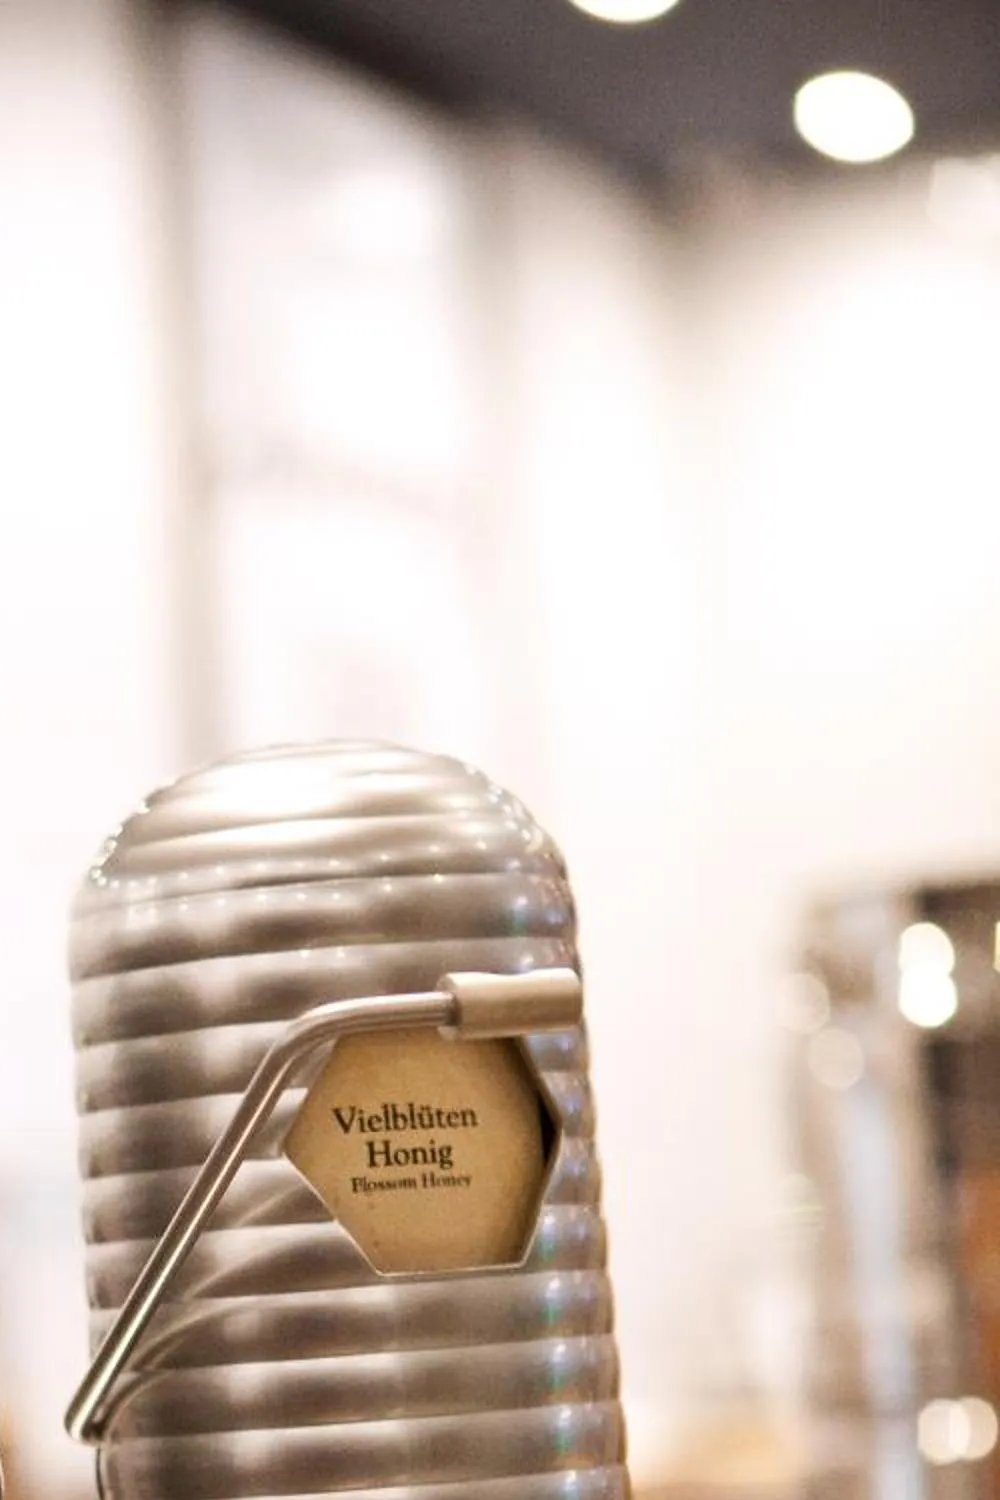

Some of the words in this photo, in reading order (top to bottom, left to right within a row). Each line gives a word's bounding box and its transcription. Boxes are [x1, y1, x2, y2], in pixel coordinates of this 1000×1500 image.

[332, 1102, 479, 1134] Vielblüten
[366, 1139, 454, 1169] Honig
[351, 1175, 418, 1195] Blossom
[422, 1172, 473, 1190] Honey
